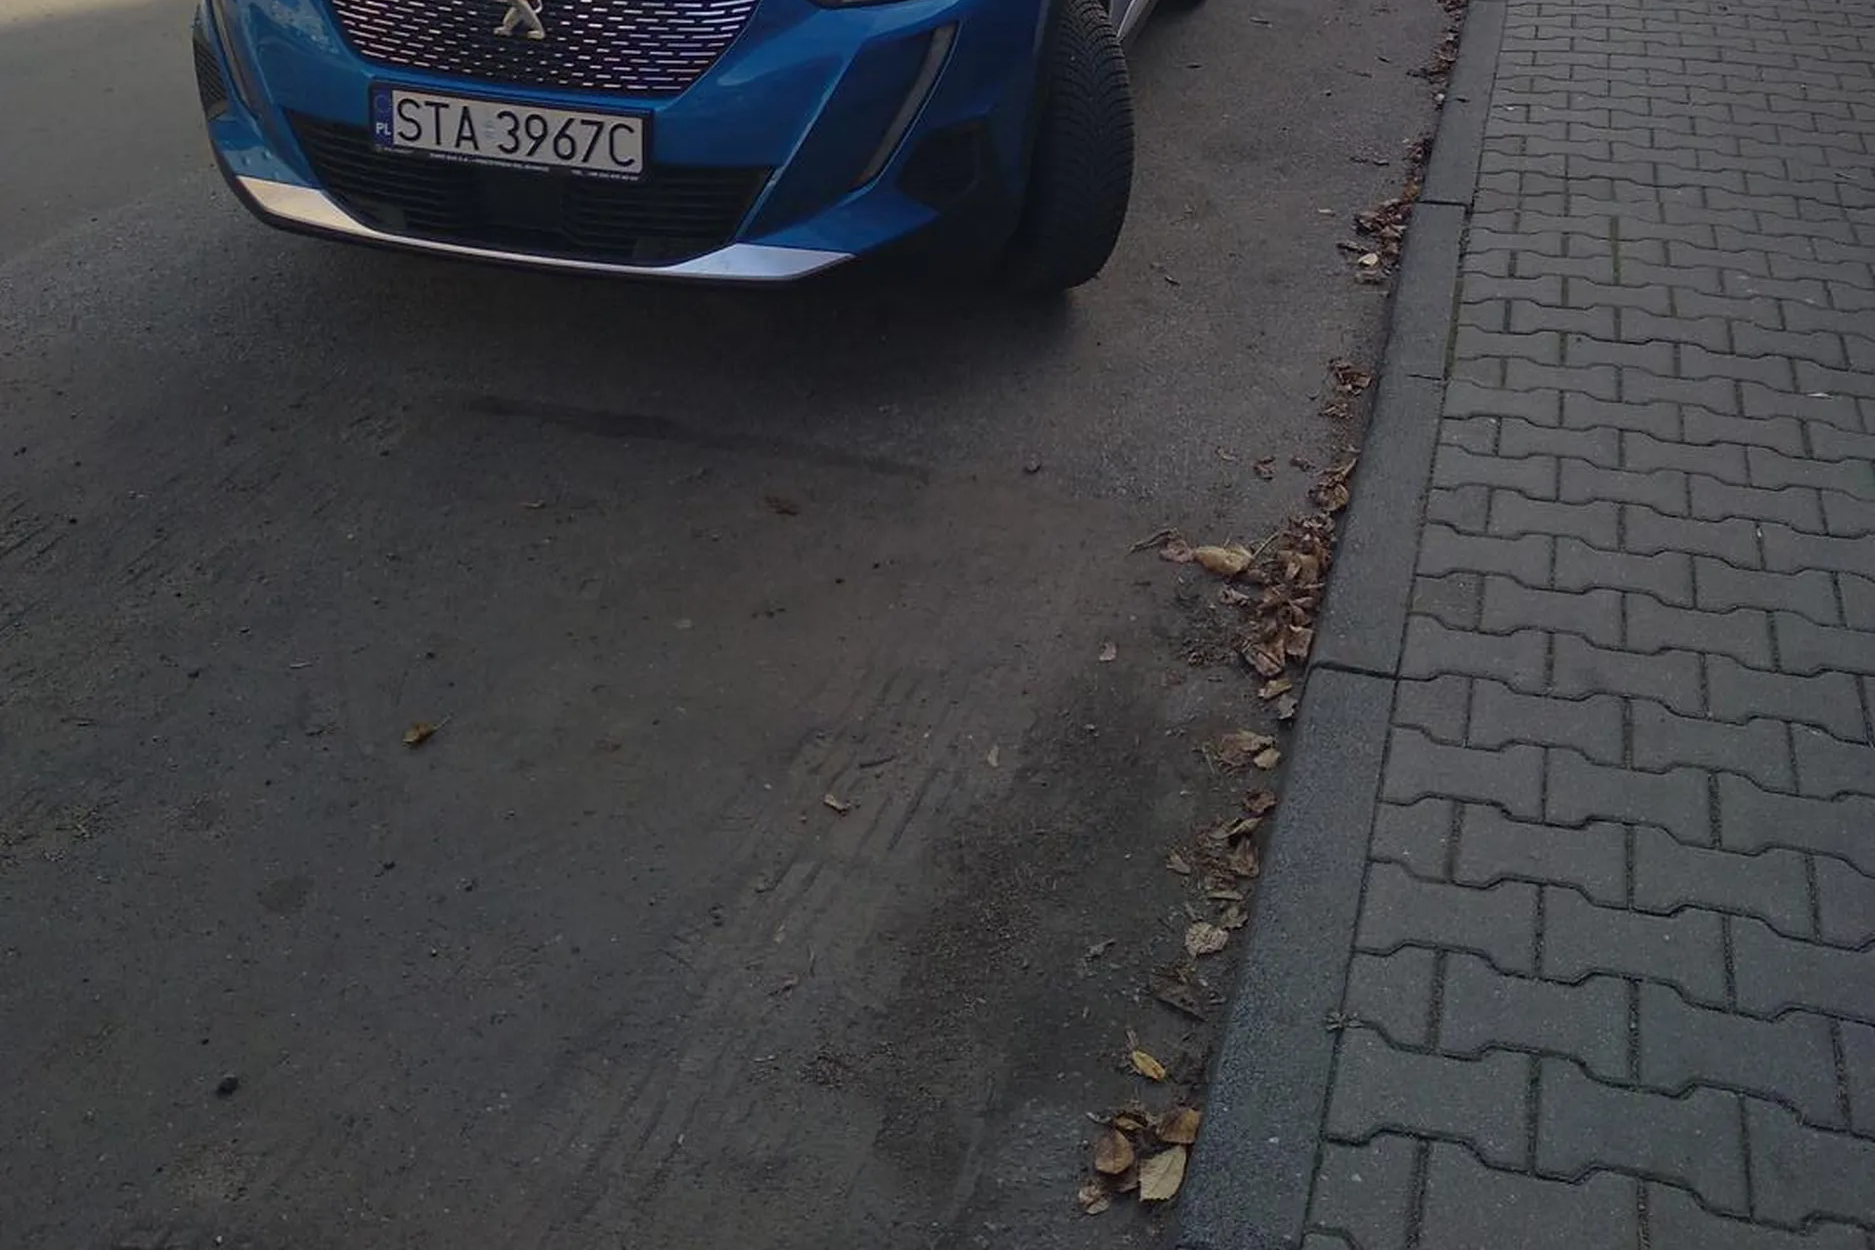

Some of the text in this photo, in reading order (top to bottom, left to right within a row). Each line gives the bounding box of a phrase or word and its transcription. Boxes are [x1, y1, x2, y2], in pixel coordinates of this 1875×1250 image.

[376, 122, 391, 135] PL
[397, 98, 635, 167] STA 3967C
